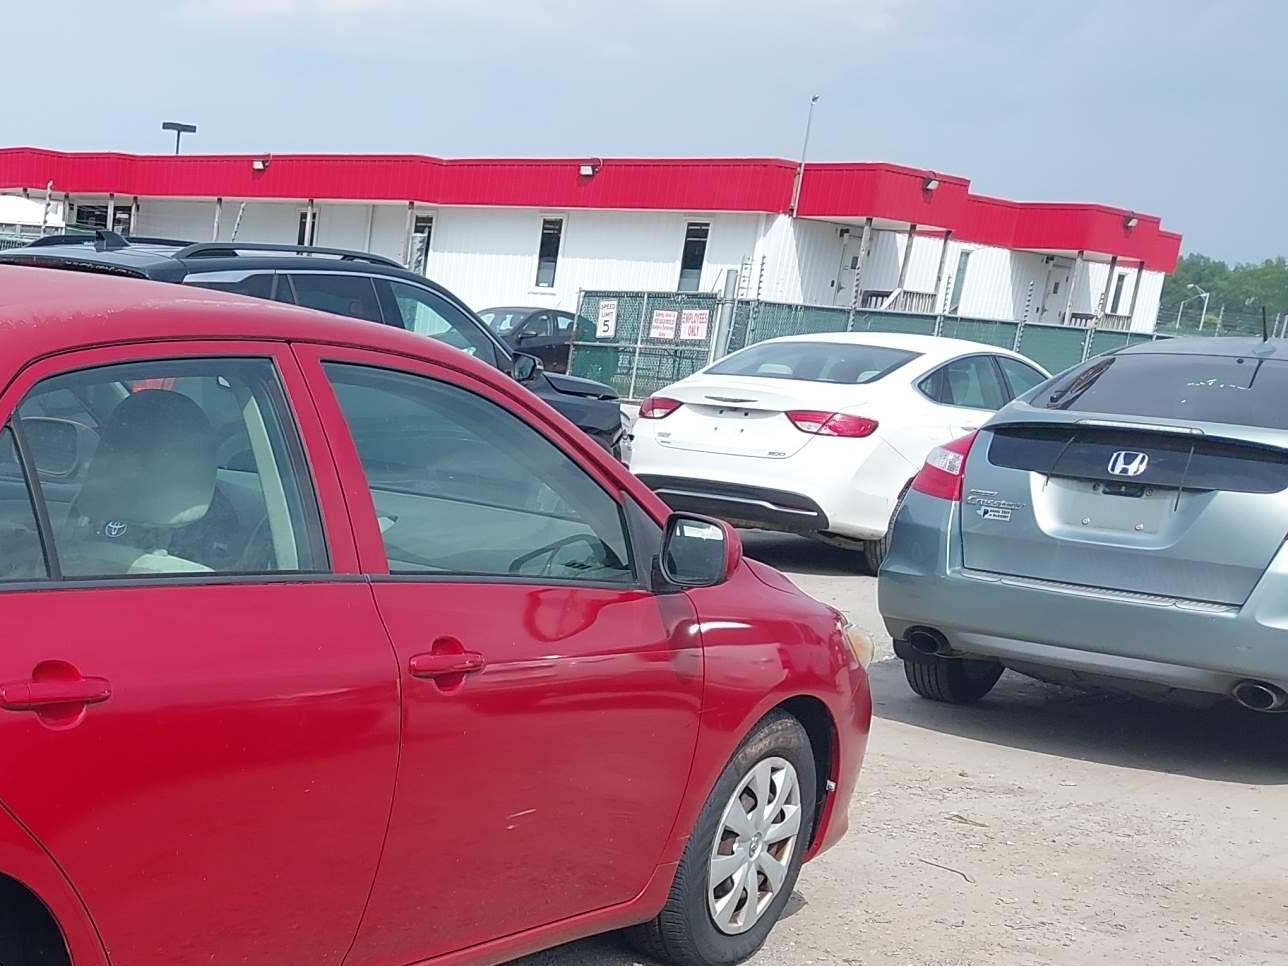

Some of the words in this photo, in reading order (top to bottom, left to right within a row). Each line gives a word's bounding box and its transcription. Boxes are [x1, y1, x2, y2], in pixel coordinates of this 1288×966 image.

[681, 312, 708, 324] EMPLOYEES
[602, 320, 610, 333] 5
[688, 324, 700, 337] ONLY
